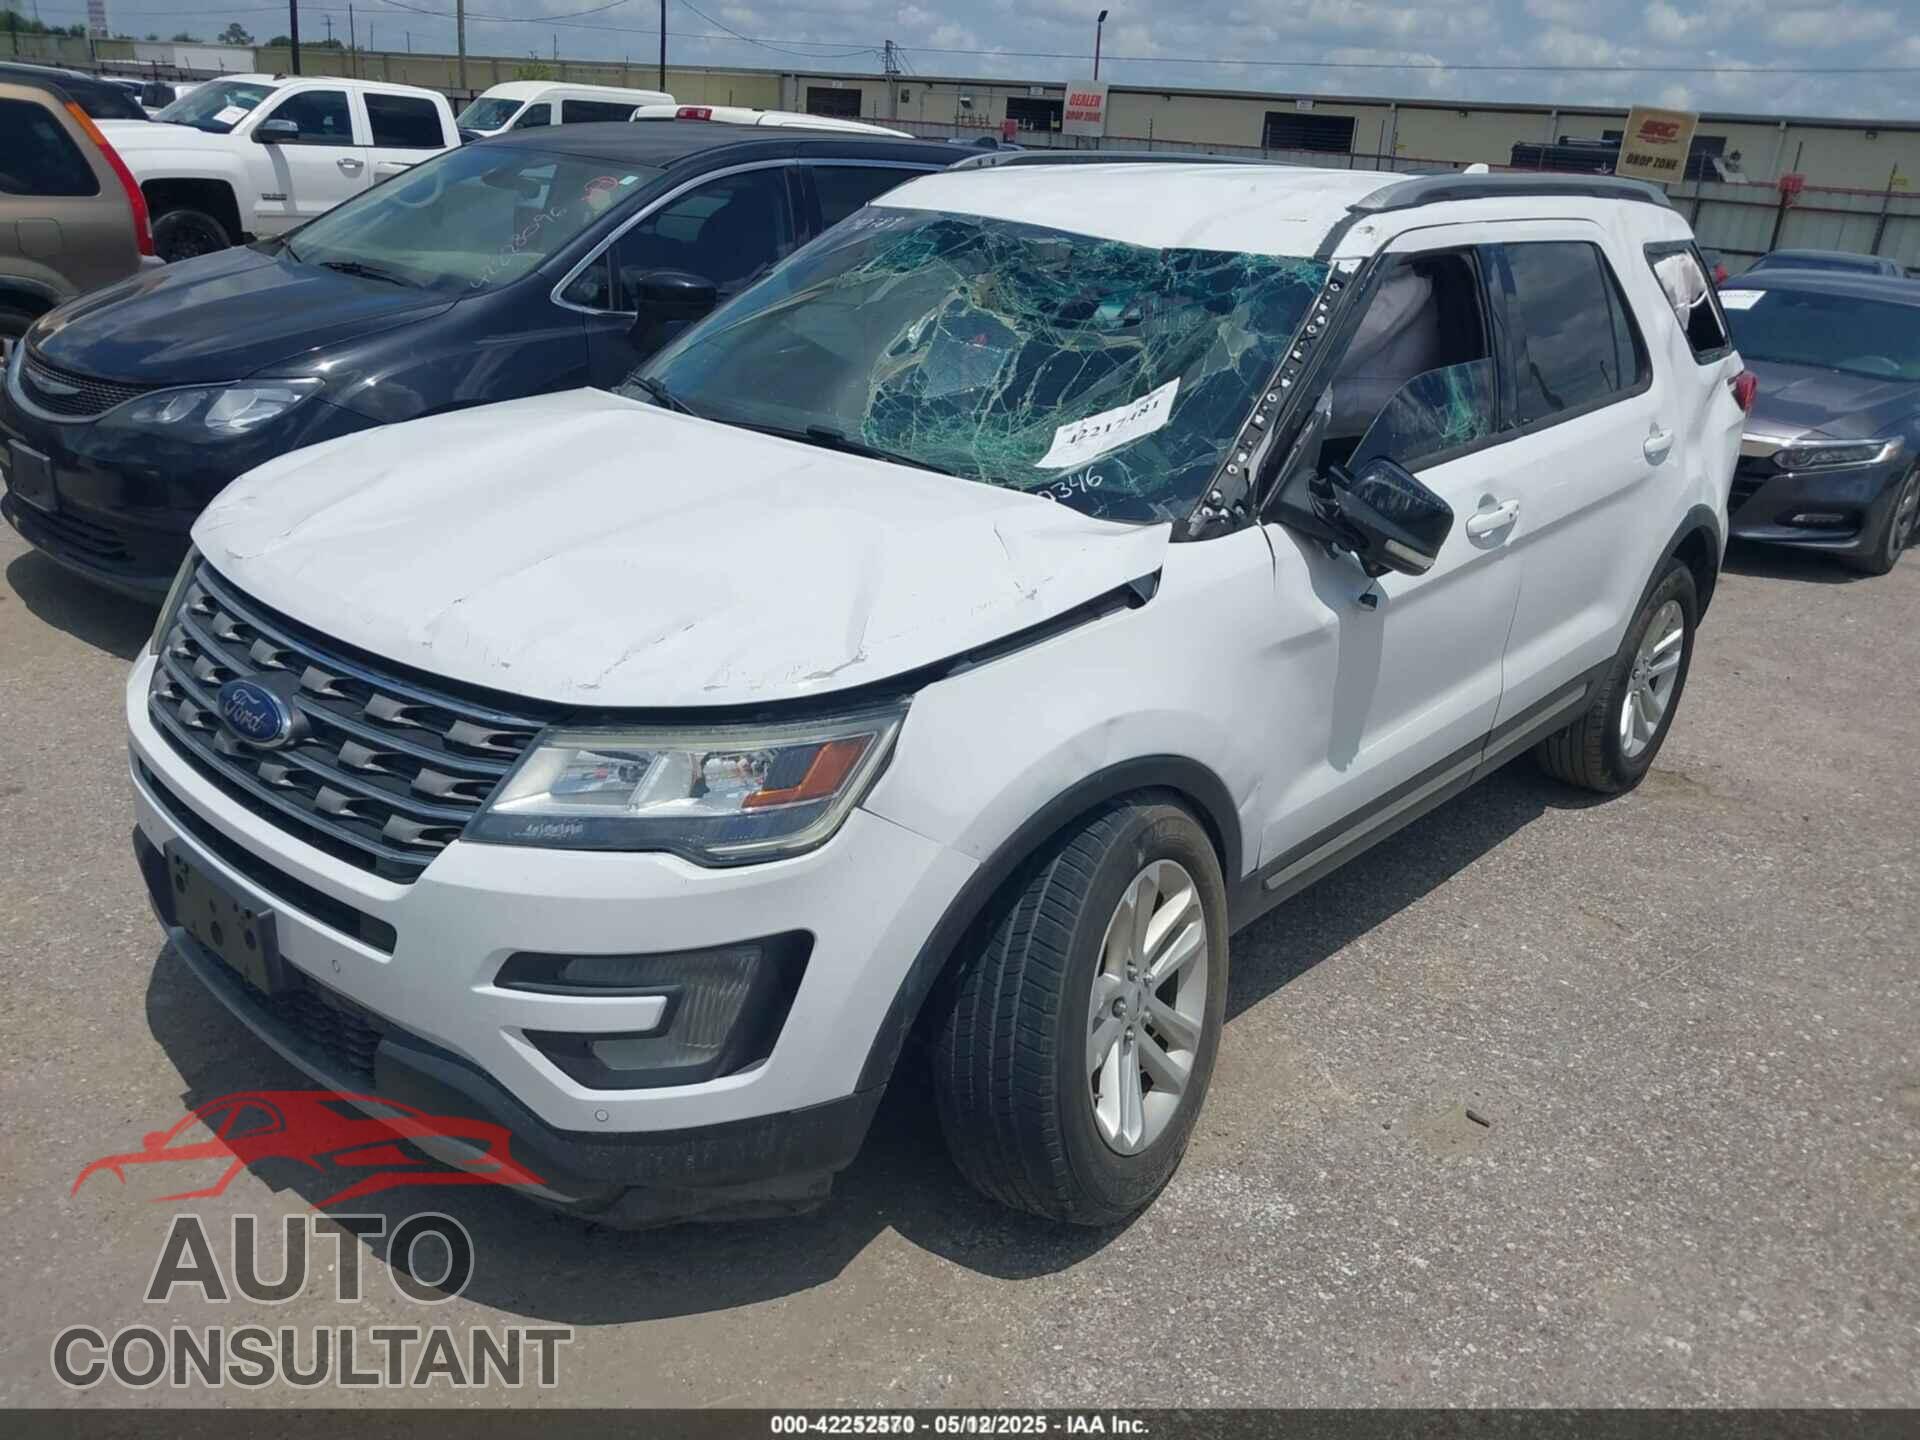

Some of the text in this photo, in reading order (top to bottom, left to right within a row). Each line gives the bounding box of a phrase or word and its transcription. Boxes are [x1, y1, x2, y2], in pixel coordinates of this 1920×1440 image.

[1069, 93, 1102, 108] DEALER
[1625, 153, 1679, 171] DROP ZONE
[224, 688, 267, 732] Ford
